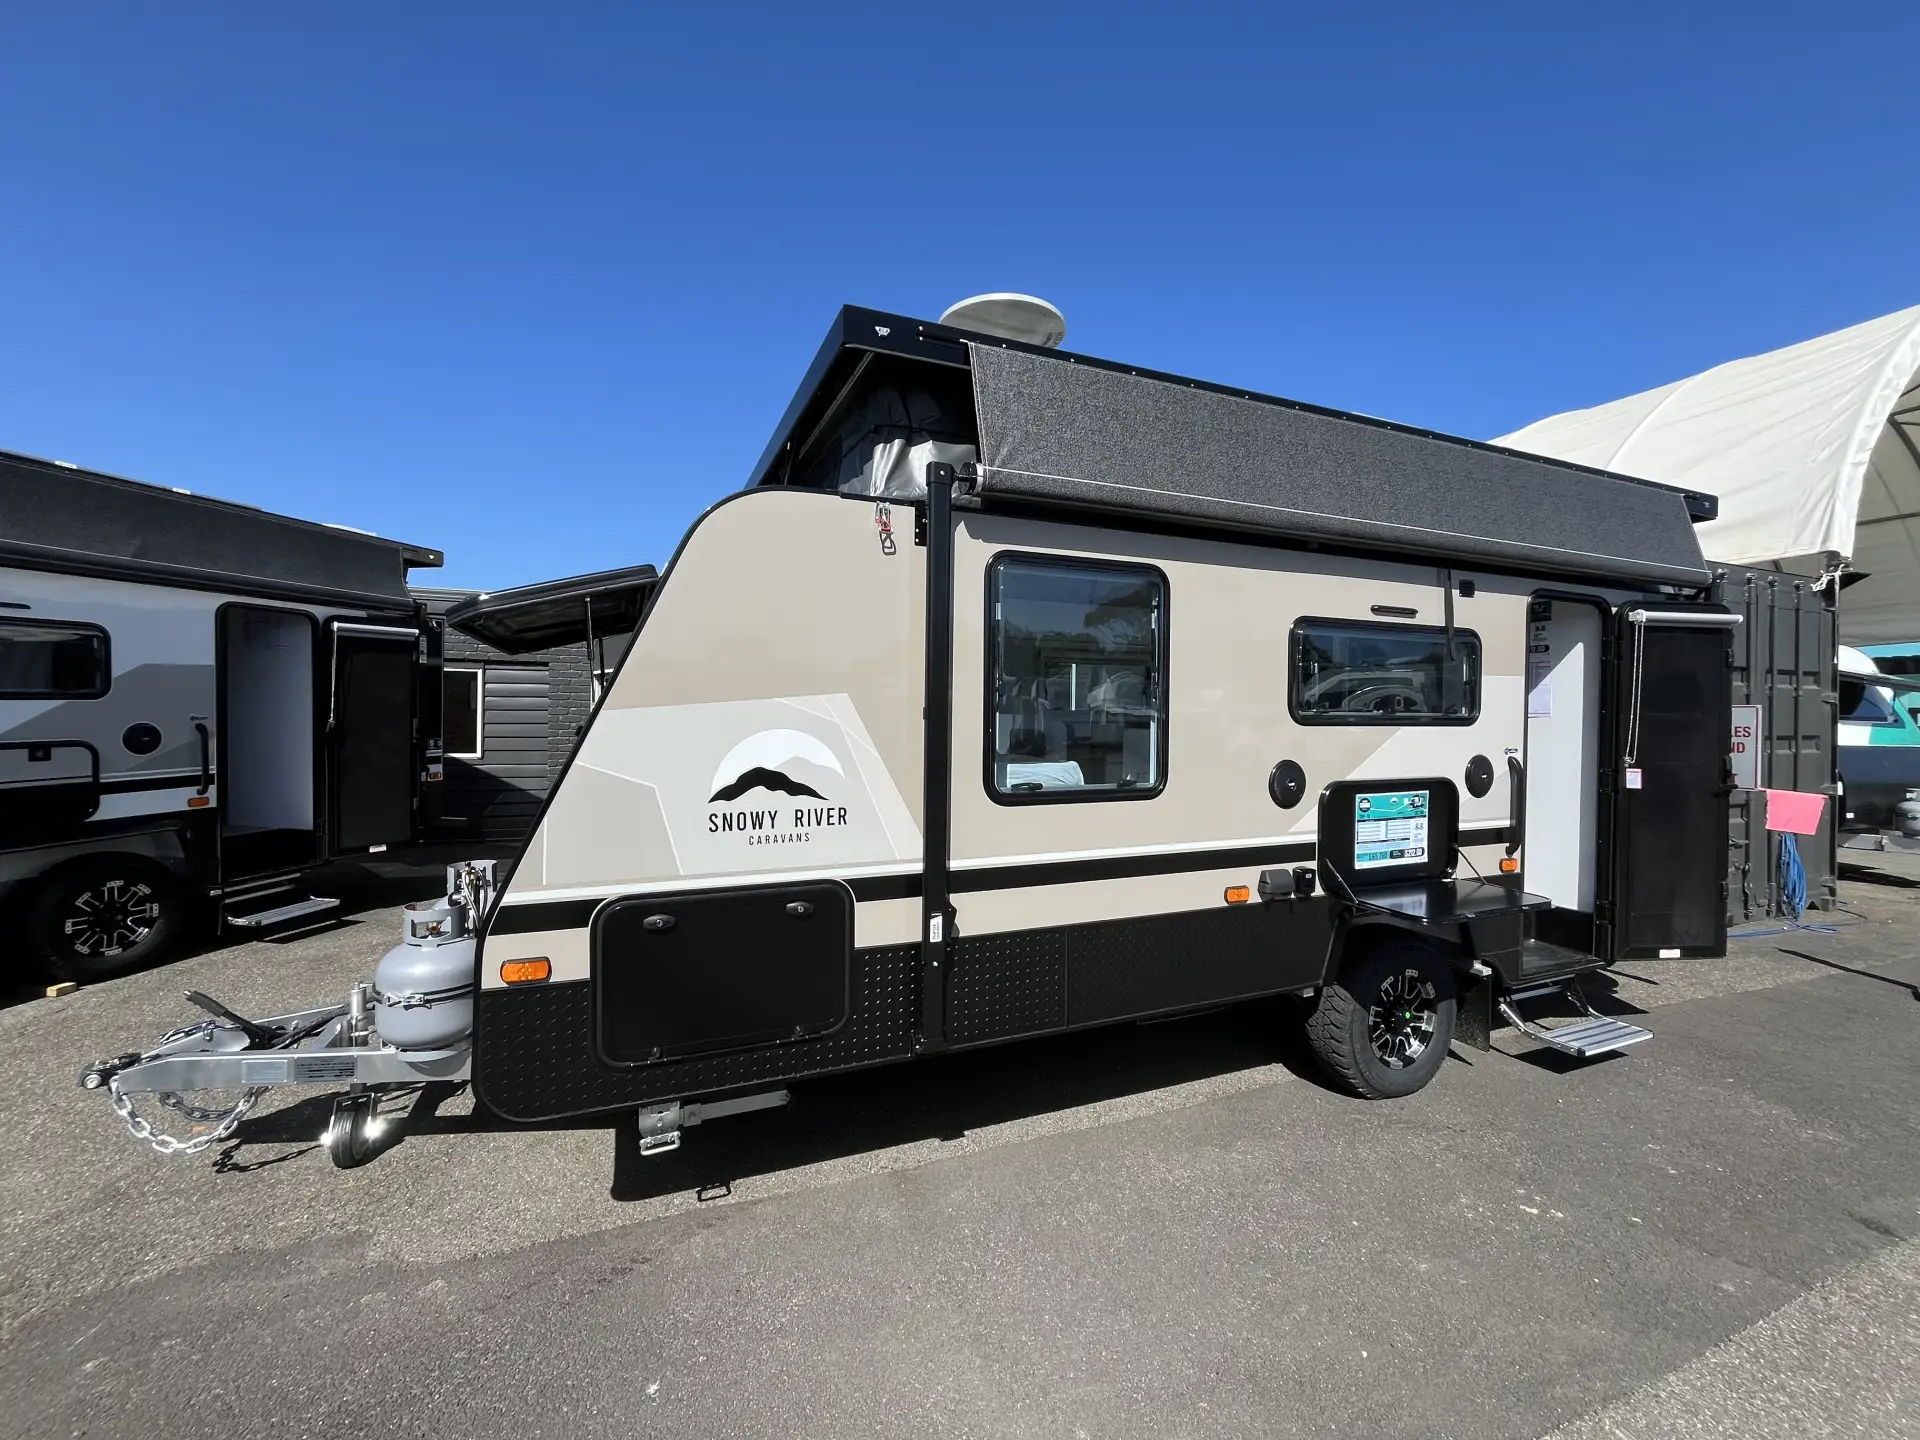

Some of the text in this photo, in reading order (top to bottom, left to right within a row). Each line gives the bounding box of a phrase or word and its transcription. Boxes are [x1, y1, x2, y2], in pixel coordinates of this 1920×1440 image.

[1732, 726, 1751, 738] ES
[708, 807, 848, 833] SNOWY RIVER
[748, 832, 810, 846] CARAVANS
